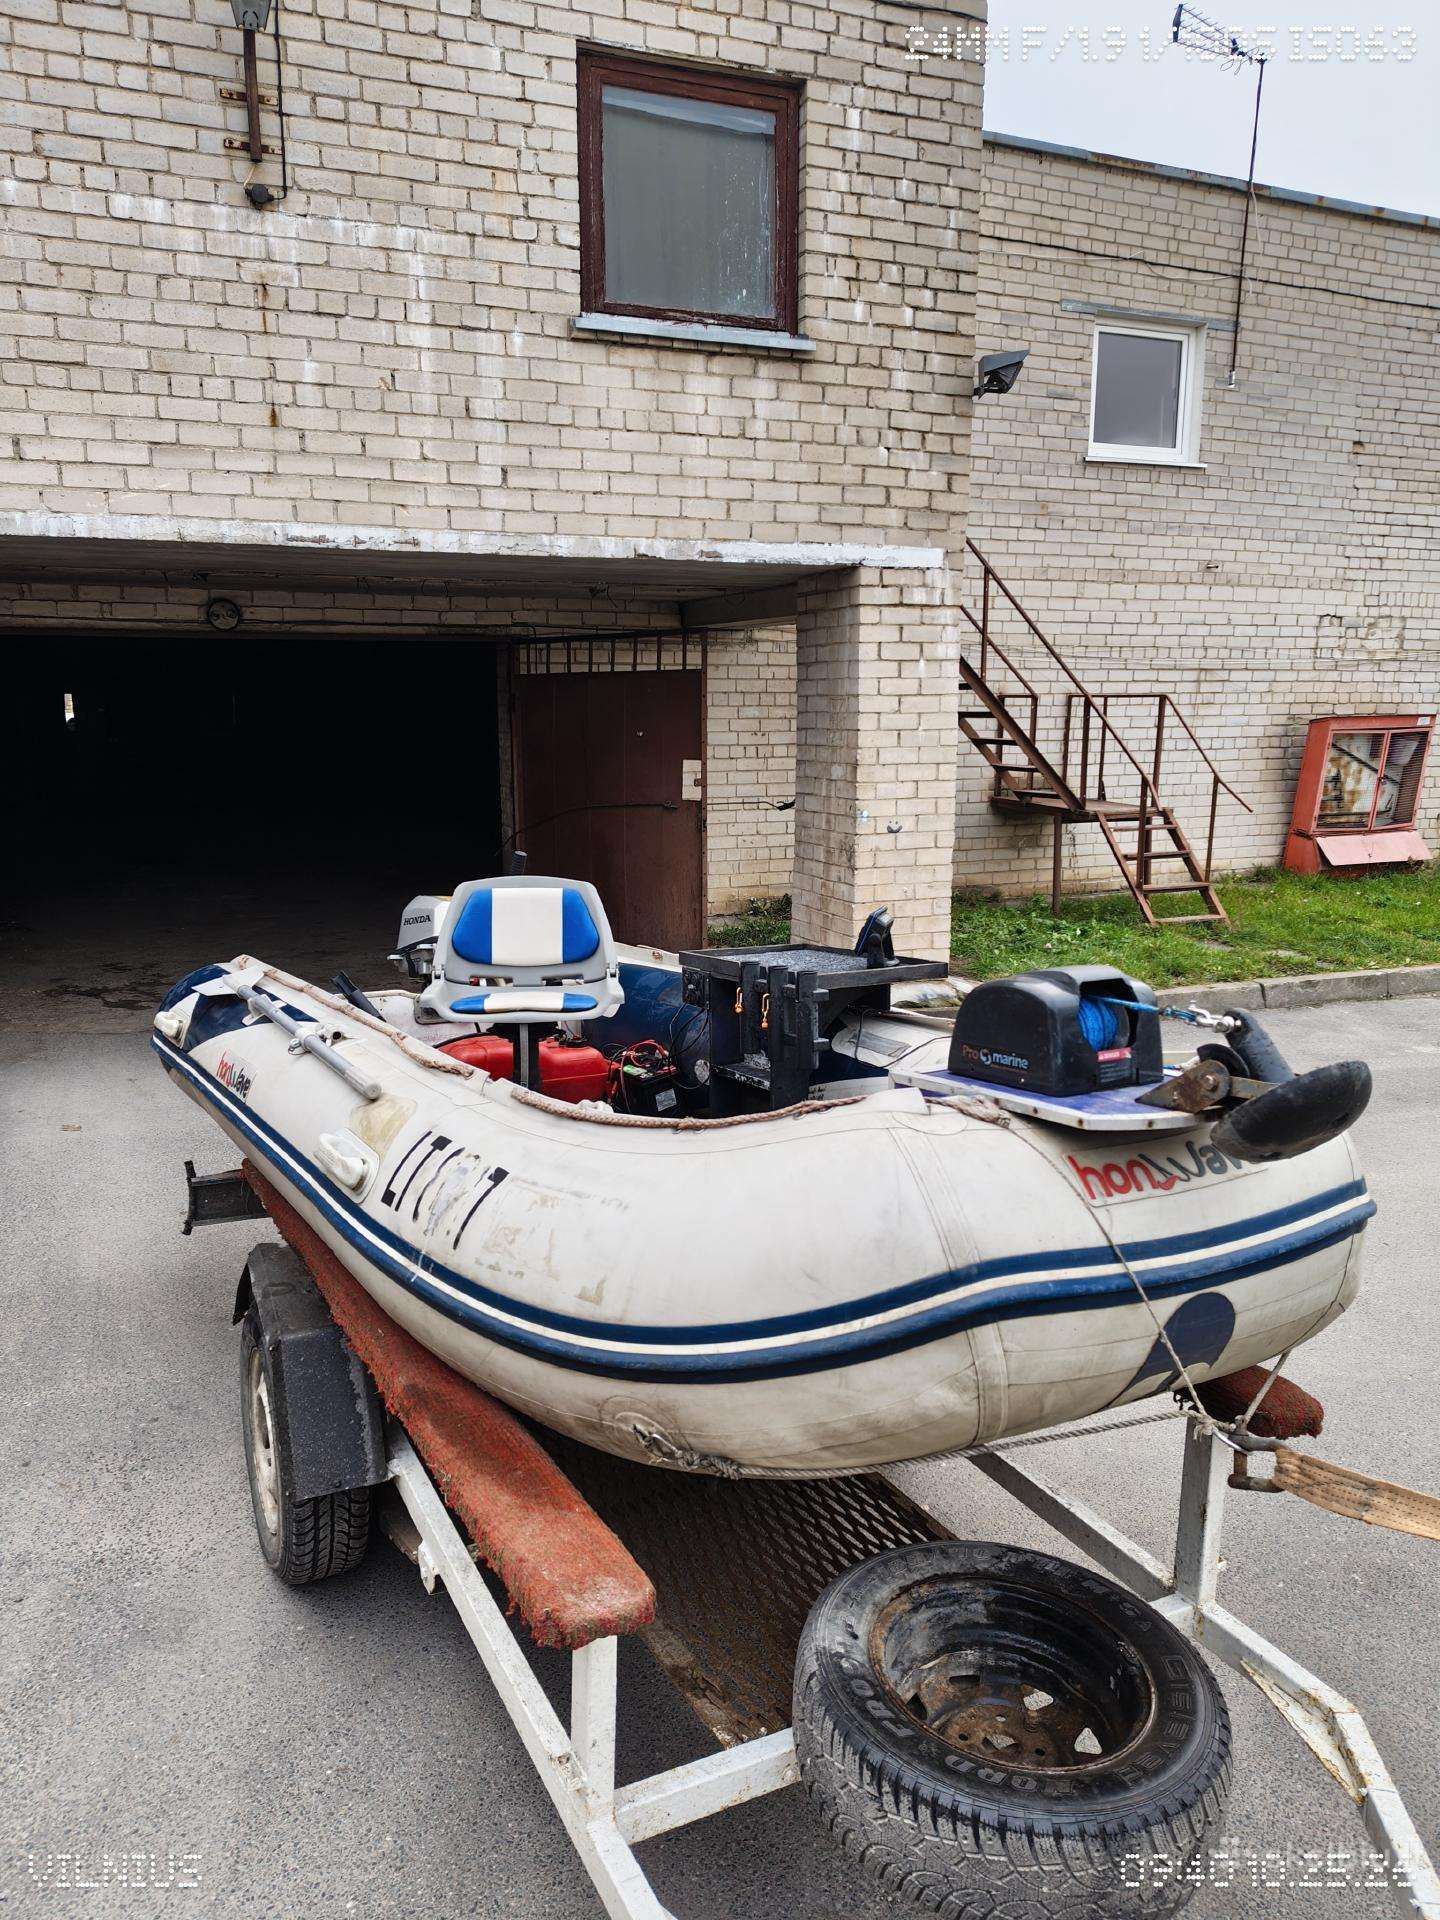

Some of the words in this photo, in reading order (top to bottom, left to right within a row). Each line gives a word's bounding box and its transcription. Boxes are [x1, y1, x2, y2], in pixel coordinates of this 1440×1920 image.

[403, 915, 432, 926] HONDA
[961, 1044, 979, 1060] Pro
[992, 1052, 1029, 1069] marine
[944, 1755, 1074, 1795] NORD
